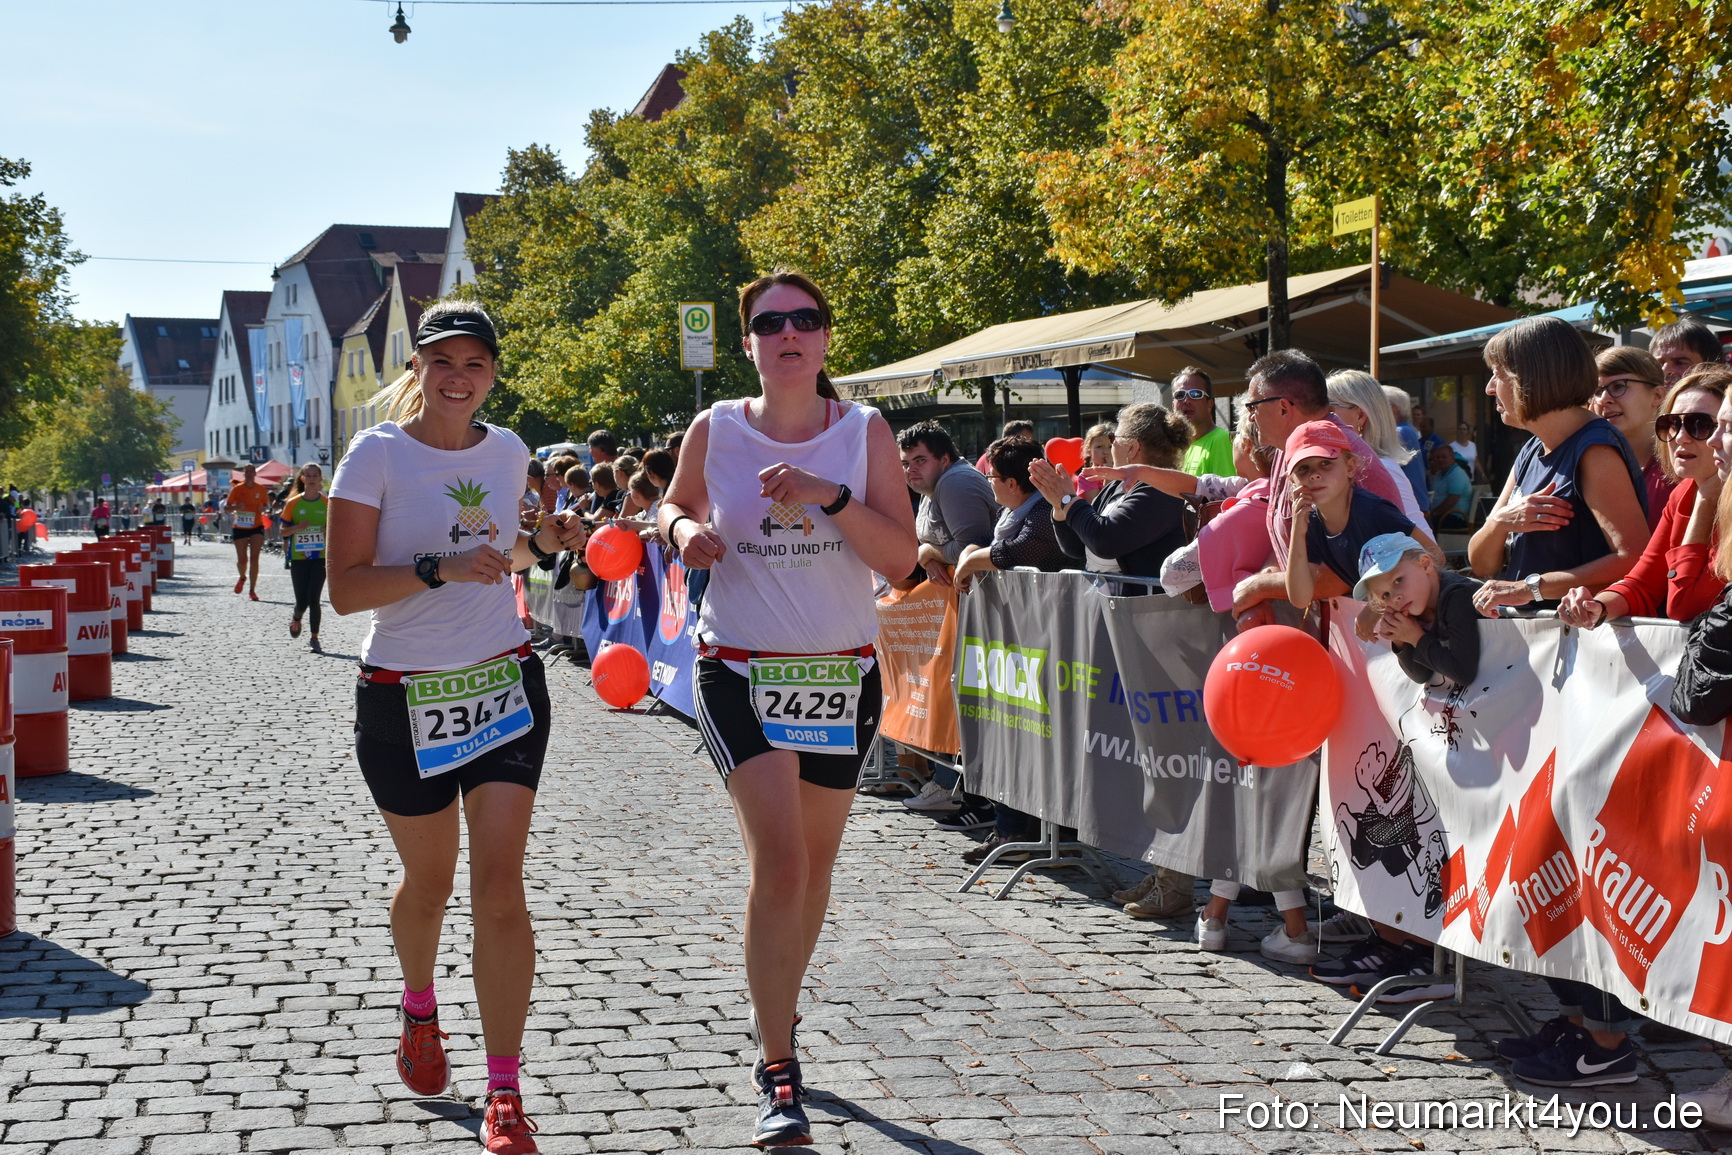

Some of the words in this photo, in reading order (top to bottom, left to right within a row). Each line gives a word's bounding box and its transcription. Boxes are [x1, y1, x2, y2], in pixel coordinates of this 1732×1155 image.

[1341, 209, 1373, 225] Toiletten
[691, 313, 704, 327] H
[298, 534, 321, 543] 2511
[737, 542, 787, 556] GESUND
[791, 543, 820, 555] UND
[823, 541, 843, 552] FIT
[768, 559, 786, 569] mit
[789, 558, 812, 569] Julia
[417, 664, 509, 699] BOCK
[760, 662, 847, 682] BOCK
[961, 642, 1043, 707] BOCK
[1259, 674, 1293, 691] energie
[424, 690, 511, 742] 2347
[765, 690, 847, 720] 2429
[452, 727, 502, 758] JULIA
[785, 729, 829, 743] DORIS
[1687, 813, 1698, 834] Seit
[1694, 785, 1712, 811] 1929
[1509, 850, 1577, 926] Braun
[1583, 819, 1672, 944] Braun
[1546, 903, 1567, 922] Sicher
[1603, 906, 1619, 936] Sicher
[1619, 929, 1629, 948] ist
[1627, 944, 1652, 970] sicher
